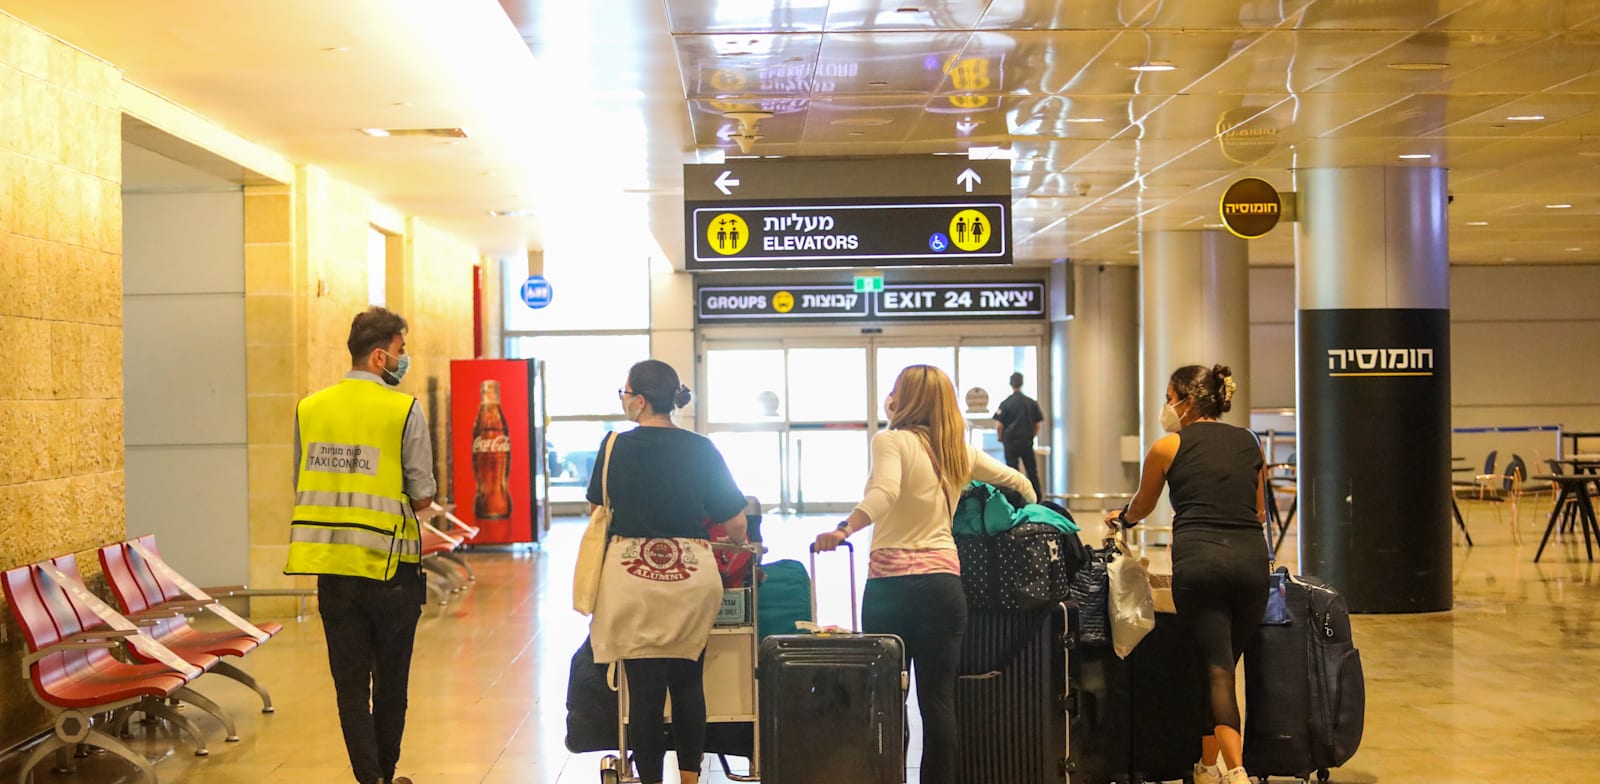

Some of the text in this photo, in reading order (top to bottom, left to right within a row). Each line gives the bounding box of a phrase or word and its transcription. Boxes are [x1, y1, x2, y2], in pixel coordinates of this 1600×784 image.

[1225, 202, 1278, 214] חומוסיה
[763, 212, 834, 231] מעליות
[763, 234, 859, 251] ELEVATORS
[706, 295, 767, 310] GROUPS
[801, 293, 858, 311] קבוצות
[884, 291, 973, 309] EXIT 24
[980, 289, 1034, 308] יציאה
[1328, 348, 1434, 370] חומוסיה
[309, 456, 372, 470] TAXI CONROL
[633, 568, 684, 581] ALUMNI
